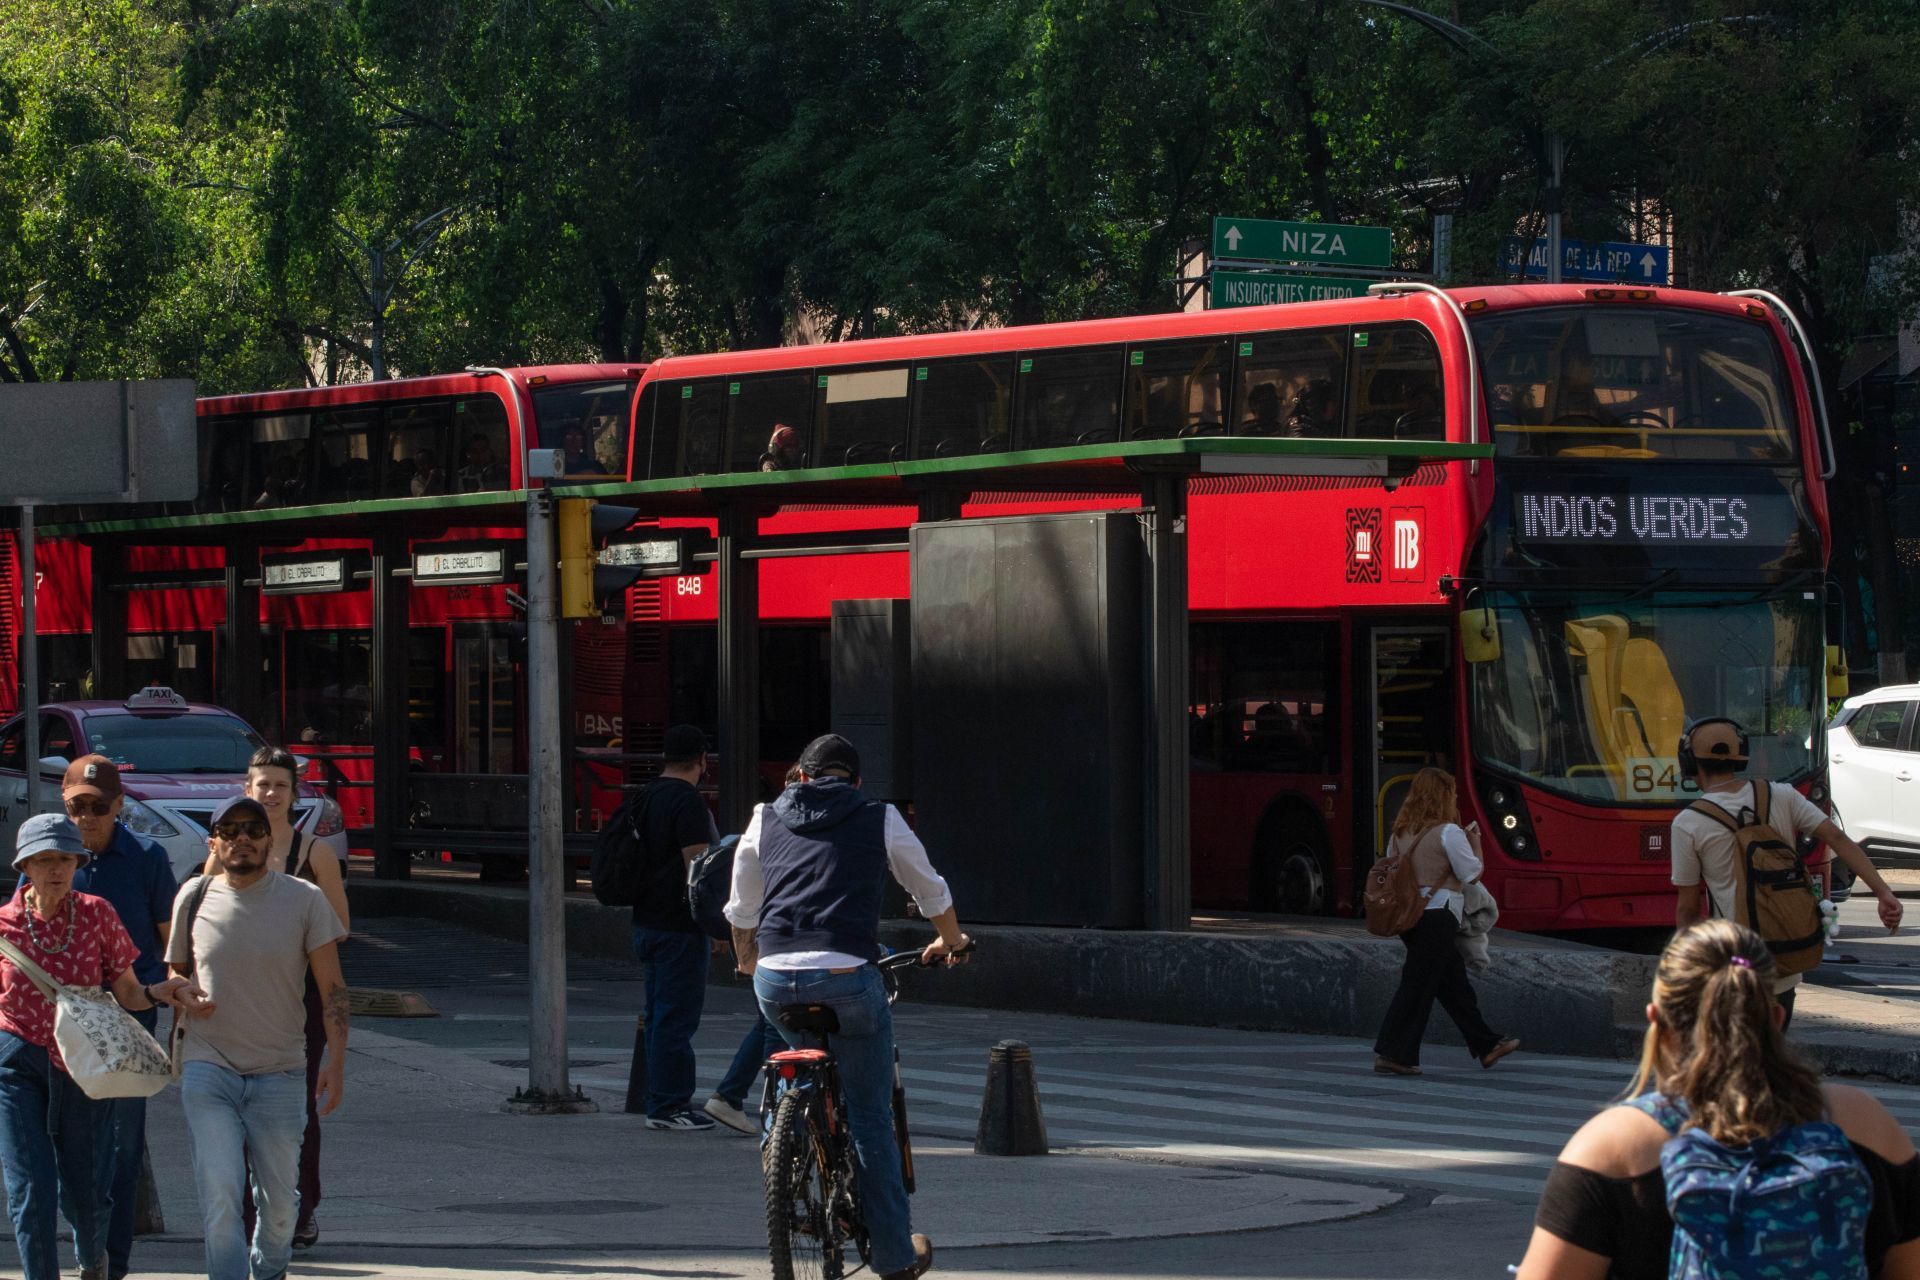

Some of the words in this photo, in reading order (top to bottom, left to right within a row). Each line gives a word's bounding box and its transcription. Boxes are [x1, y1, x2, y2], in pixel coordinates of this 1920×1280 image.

[1282, 230, 1347, 256] NIZA
[1566, 247, 1582, 270] DE
[1586, 249, 1602, 272] LA
[1226, 281, 1304, 305] INSURGENTES
[1523, 495, 1617, 537] INDIOS
[1629, 497, 1748, 539] VERDES
[677, 576, 701, 596] 848
[147, 688, 171, 699] TAXI
